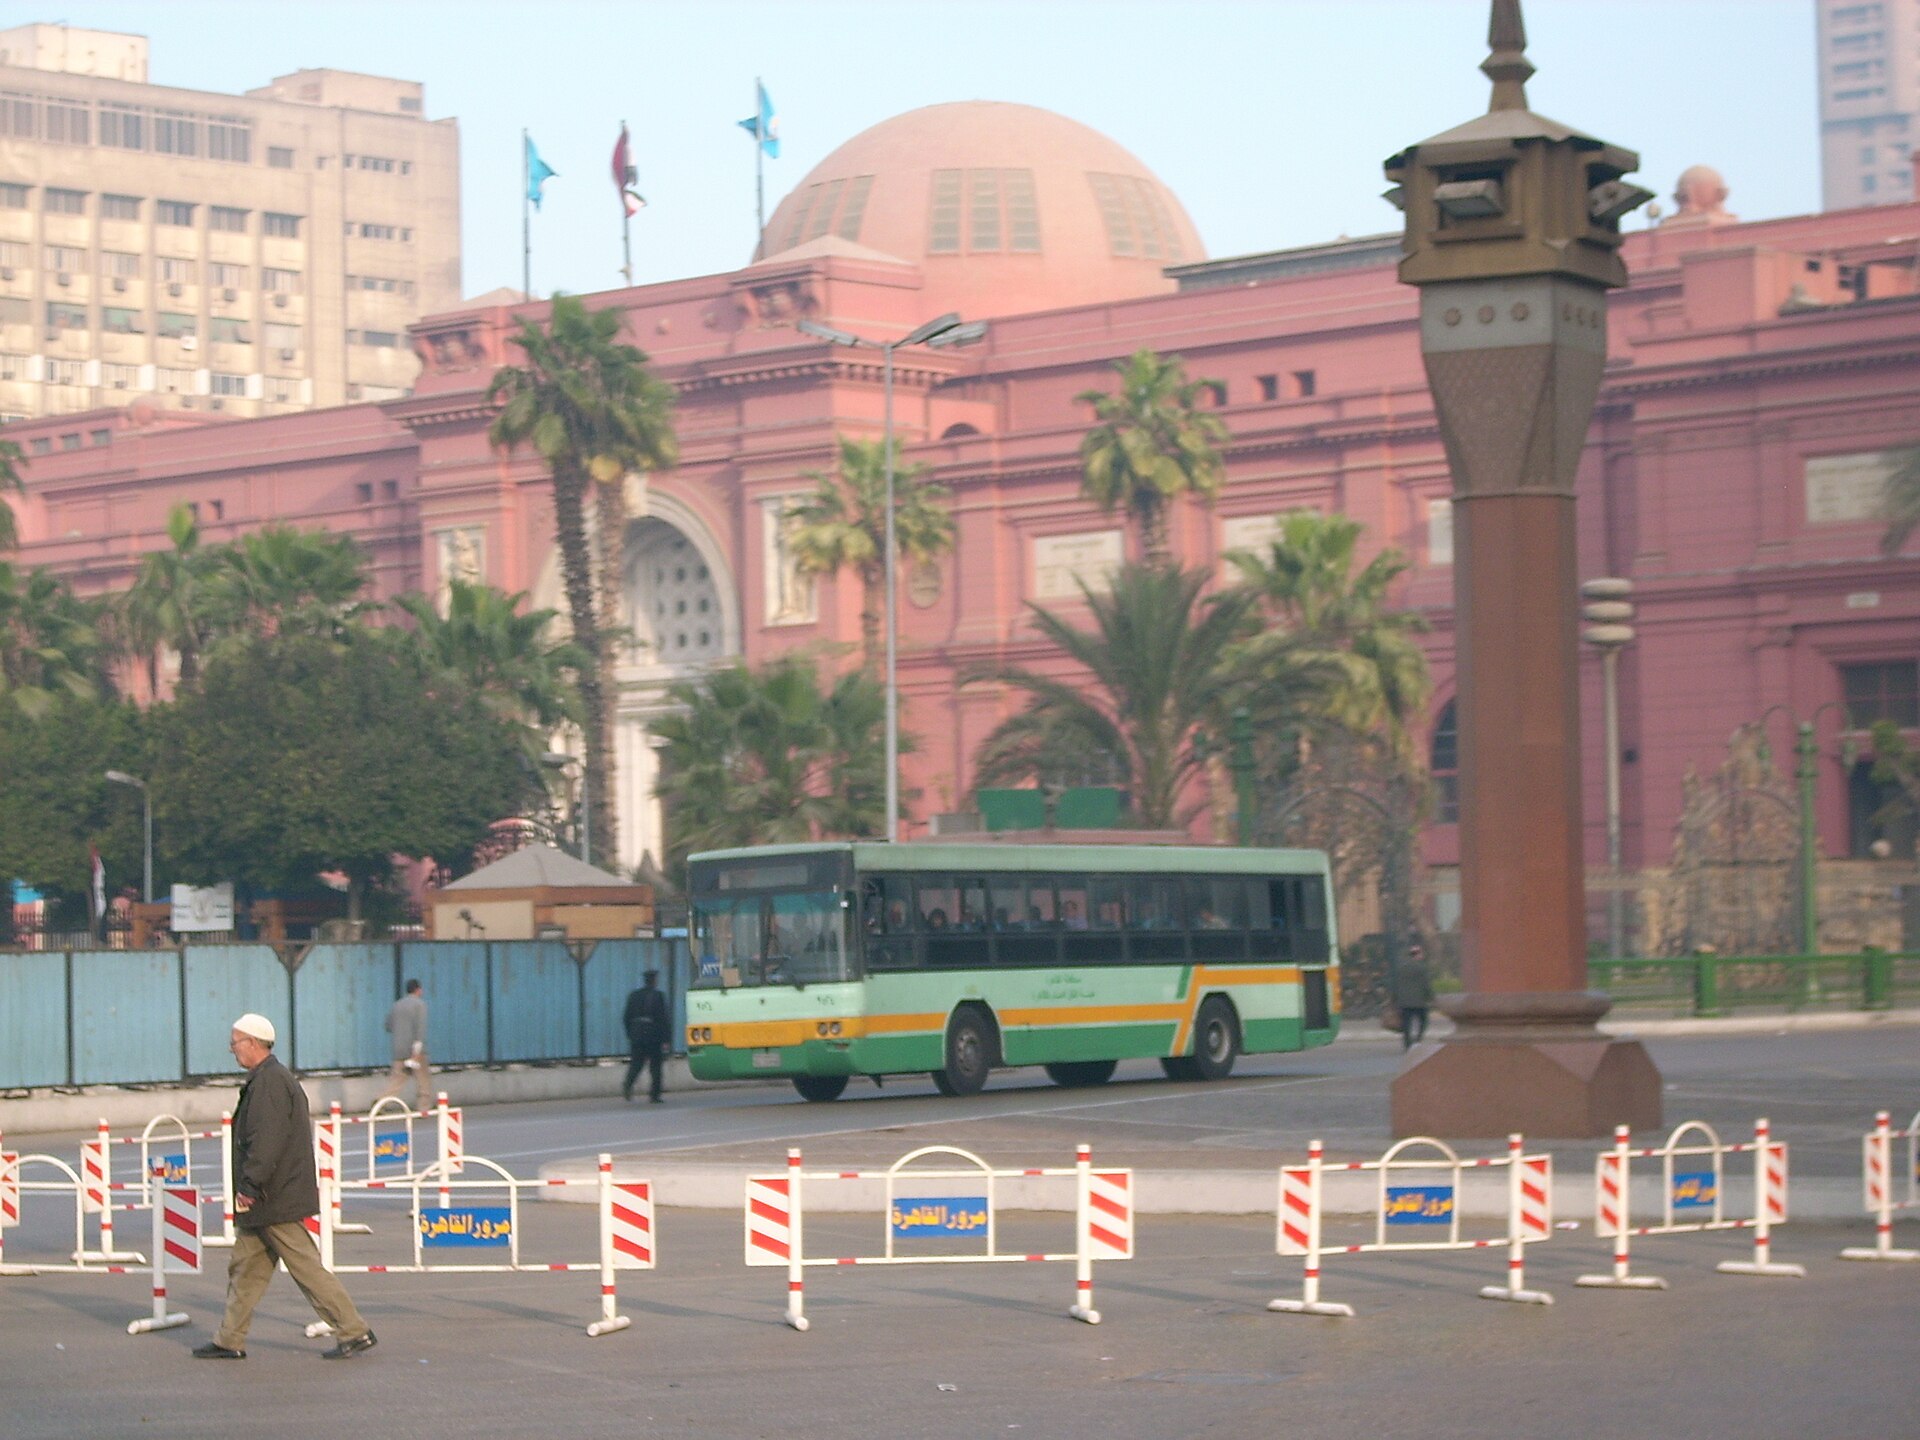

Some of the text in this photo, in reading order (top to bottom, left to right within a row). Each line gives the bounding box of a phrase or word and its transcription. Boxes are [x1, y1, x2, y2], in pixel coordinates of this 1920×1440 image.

[419, 1213, 511, 1239] مرور القاهرة
[891, 1205, 987, 1230] مرور القاهرة
